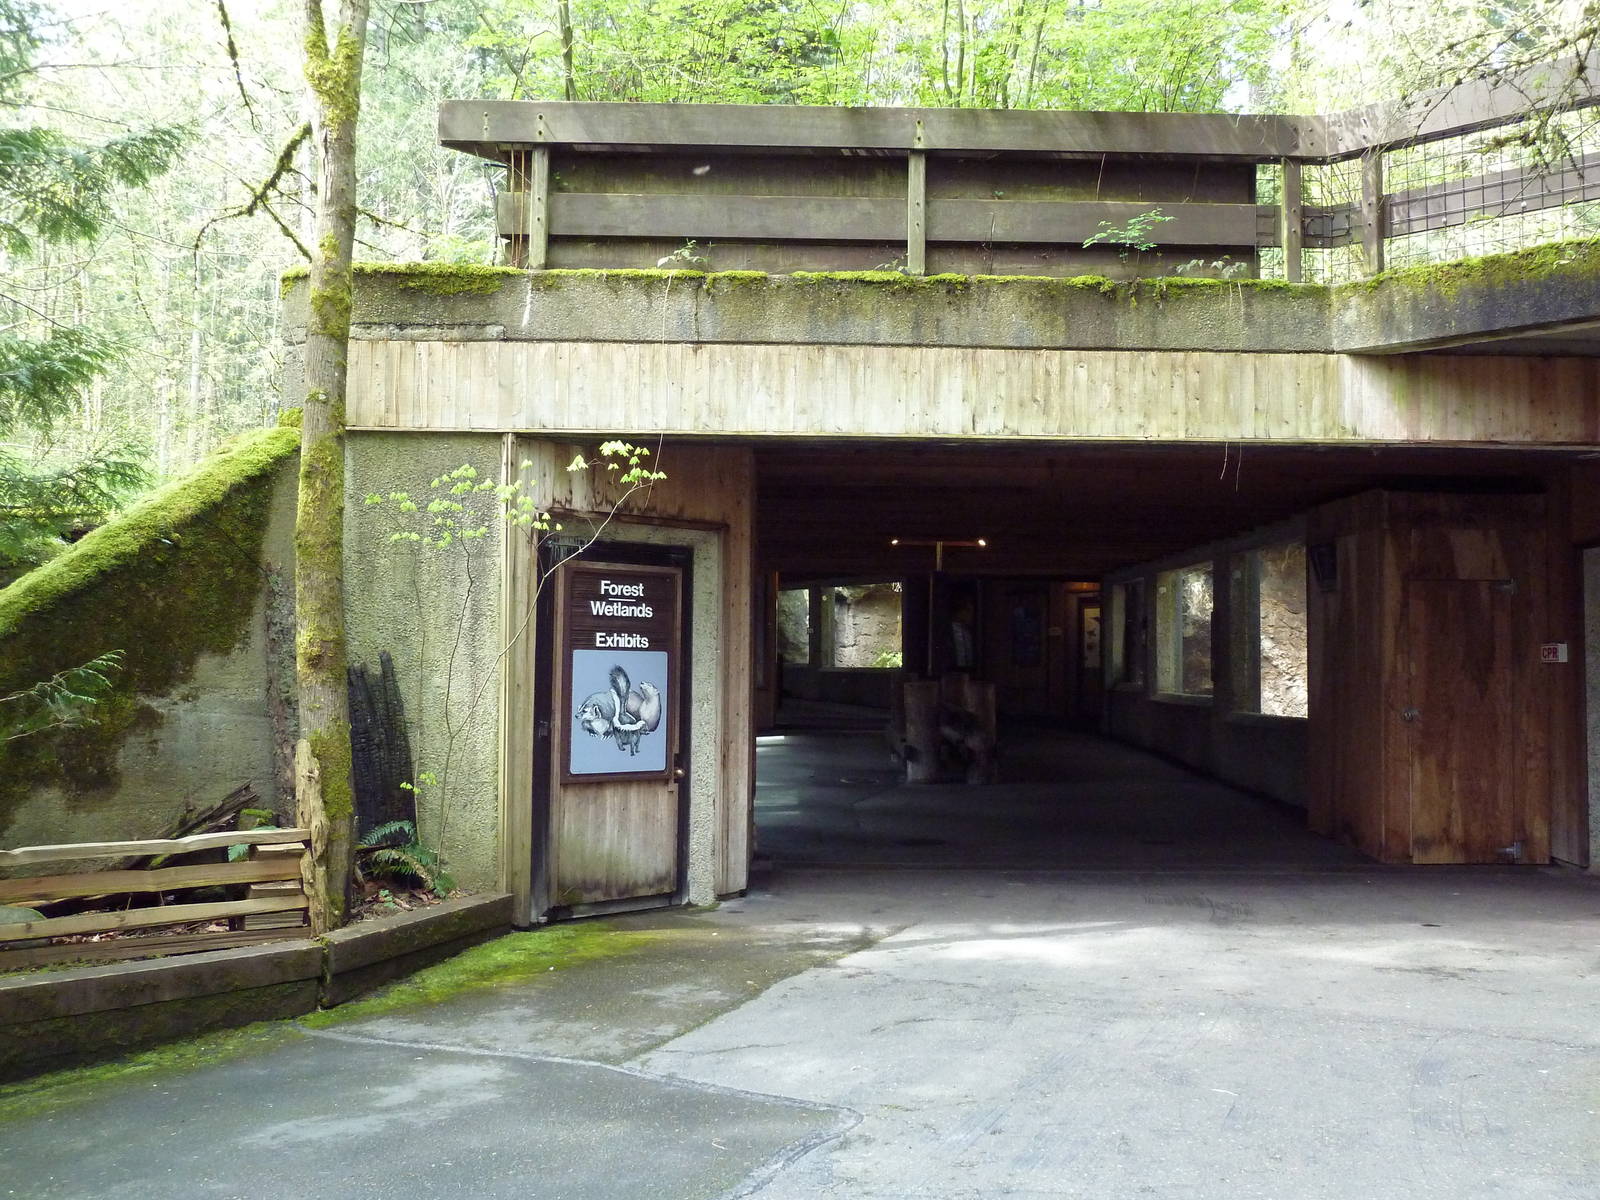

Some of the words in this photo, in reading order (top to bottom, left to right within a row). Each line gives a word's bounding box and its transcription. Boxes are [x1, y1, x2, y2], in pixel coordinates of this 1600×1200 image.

[601, 580, 644, 597] Forest
[591, 601, 653, 618] Wetlands
[596, 633, 649, 648] Exhibits
[1543, 647, 1558, 658] CPR
